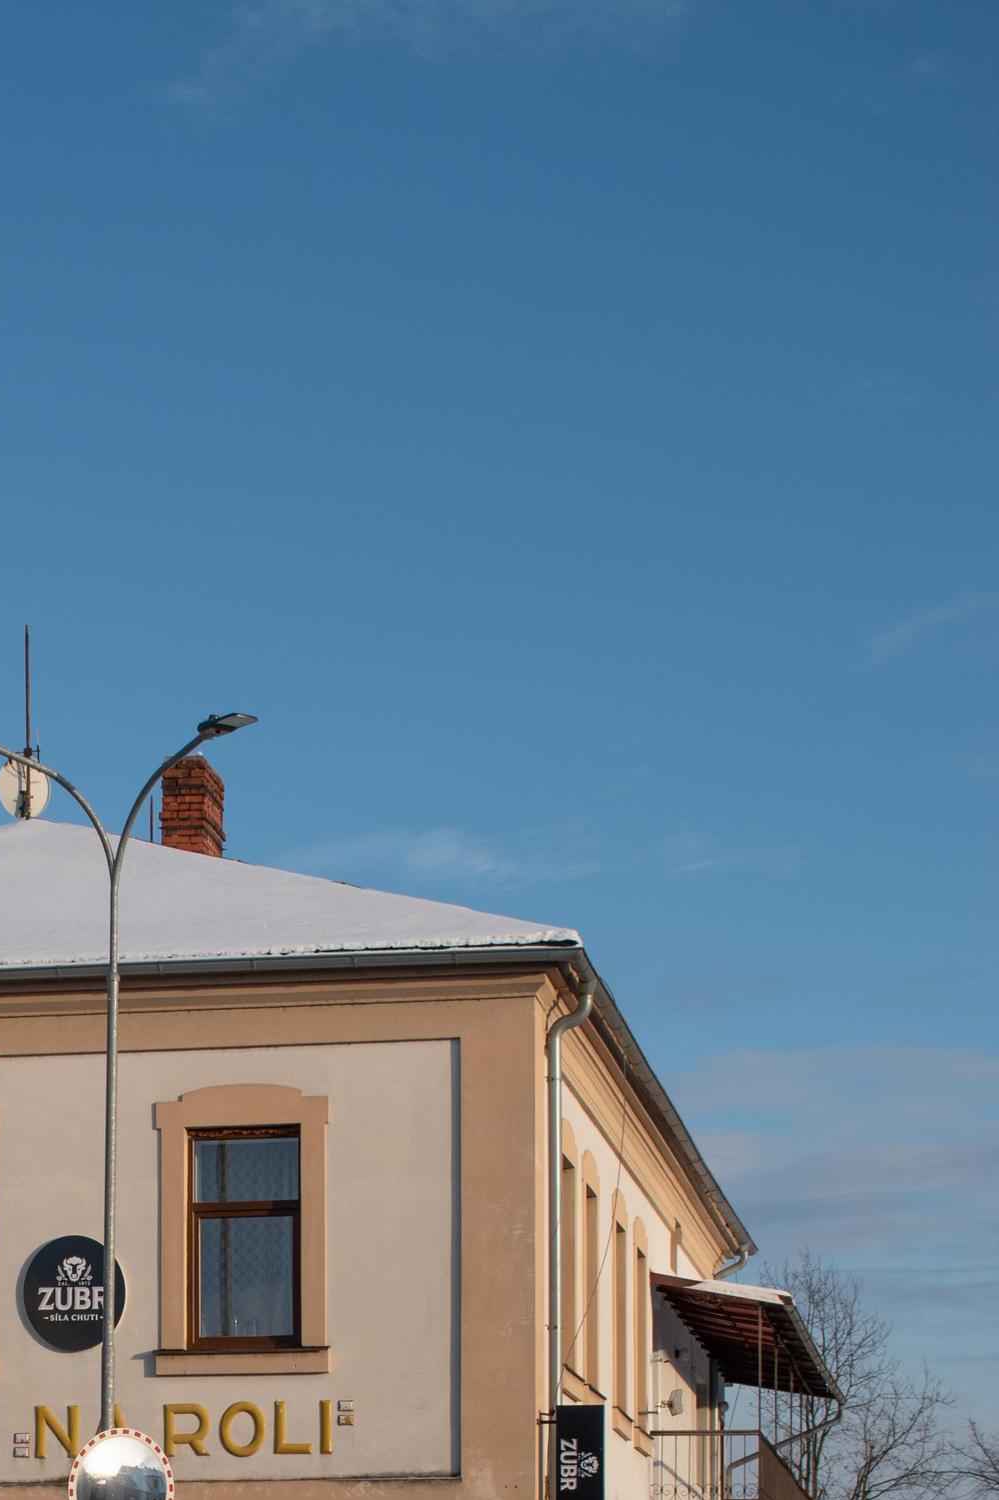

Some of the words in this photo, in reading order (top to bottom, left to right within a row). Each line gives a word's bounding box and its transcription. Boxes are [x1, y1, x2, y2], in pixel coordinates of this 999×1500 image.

[37, 1286, 104, 1311] ZUBR
[50, 1313, 69, 1321] SÍLA
[163, 1400, 333, 1457] ROLI
[560, 1438, 577, 1491] ZUBR
